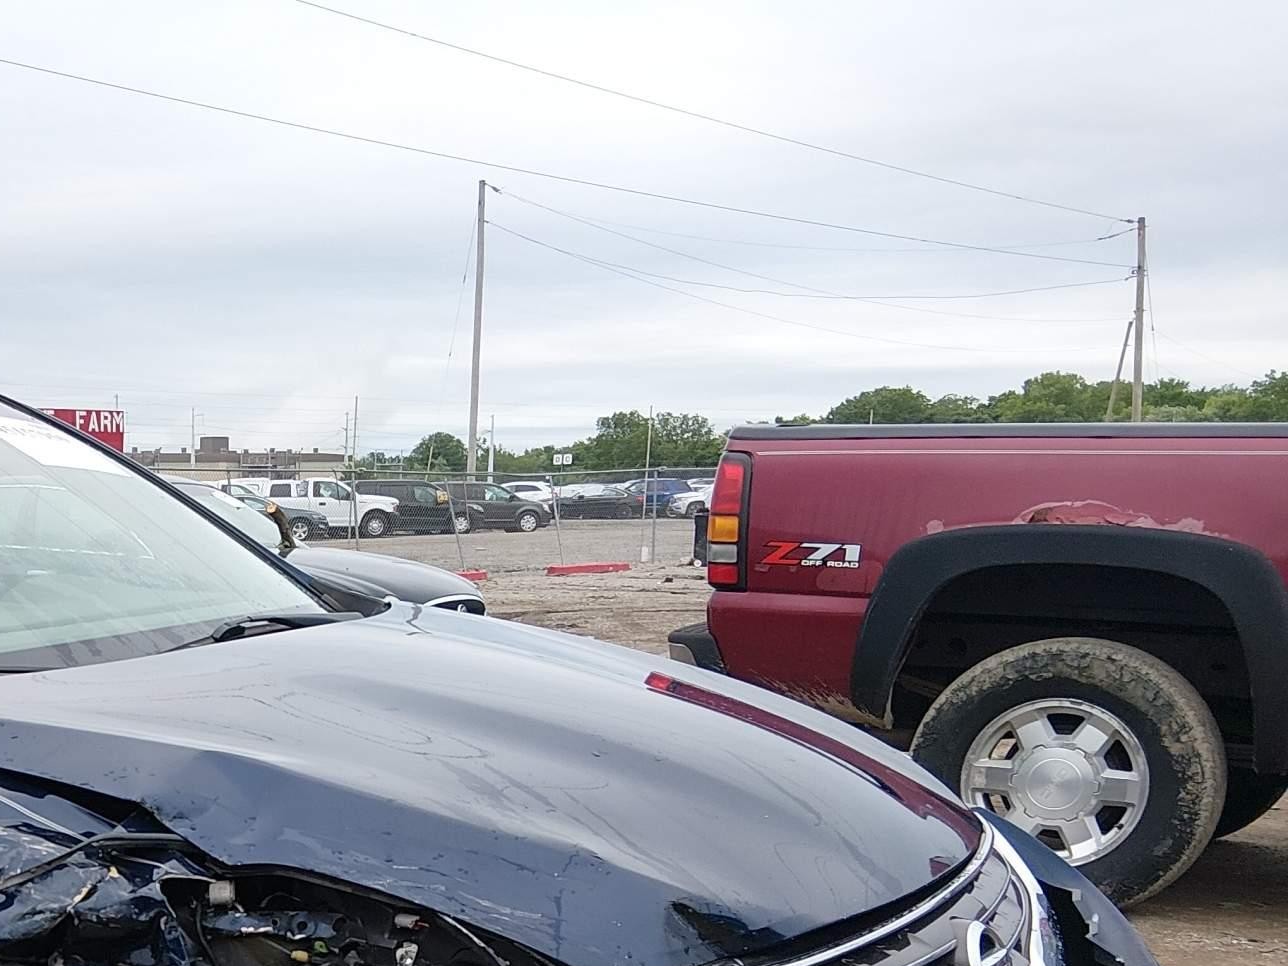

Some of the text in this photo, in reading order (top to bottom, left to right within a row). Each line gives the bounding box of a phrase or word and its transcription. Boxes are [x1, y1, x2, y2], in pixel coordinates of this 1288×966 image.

[75, 410, 123, 433] FARM
[761, 541, 861, 565] Z71
[800, 559, 859, 569] OFF ROAD
